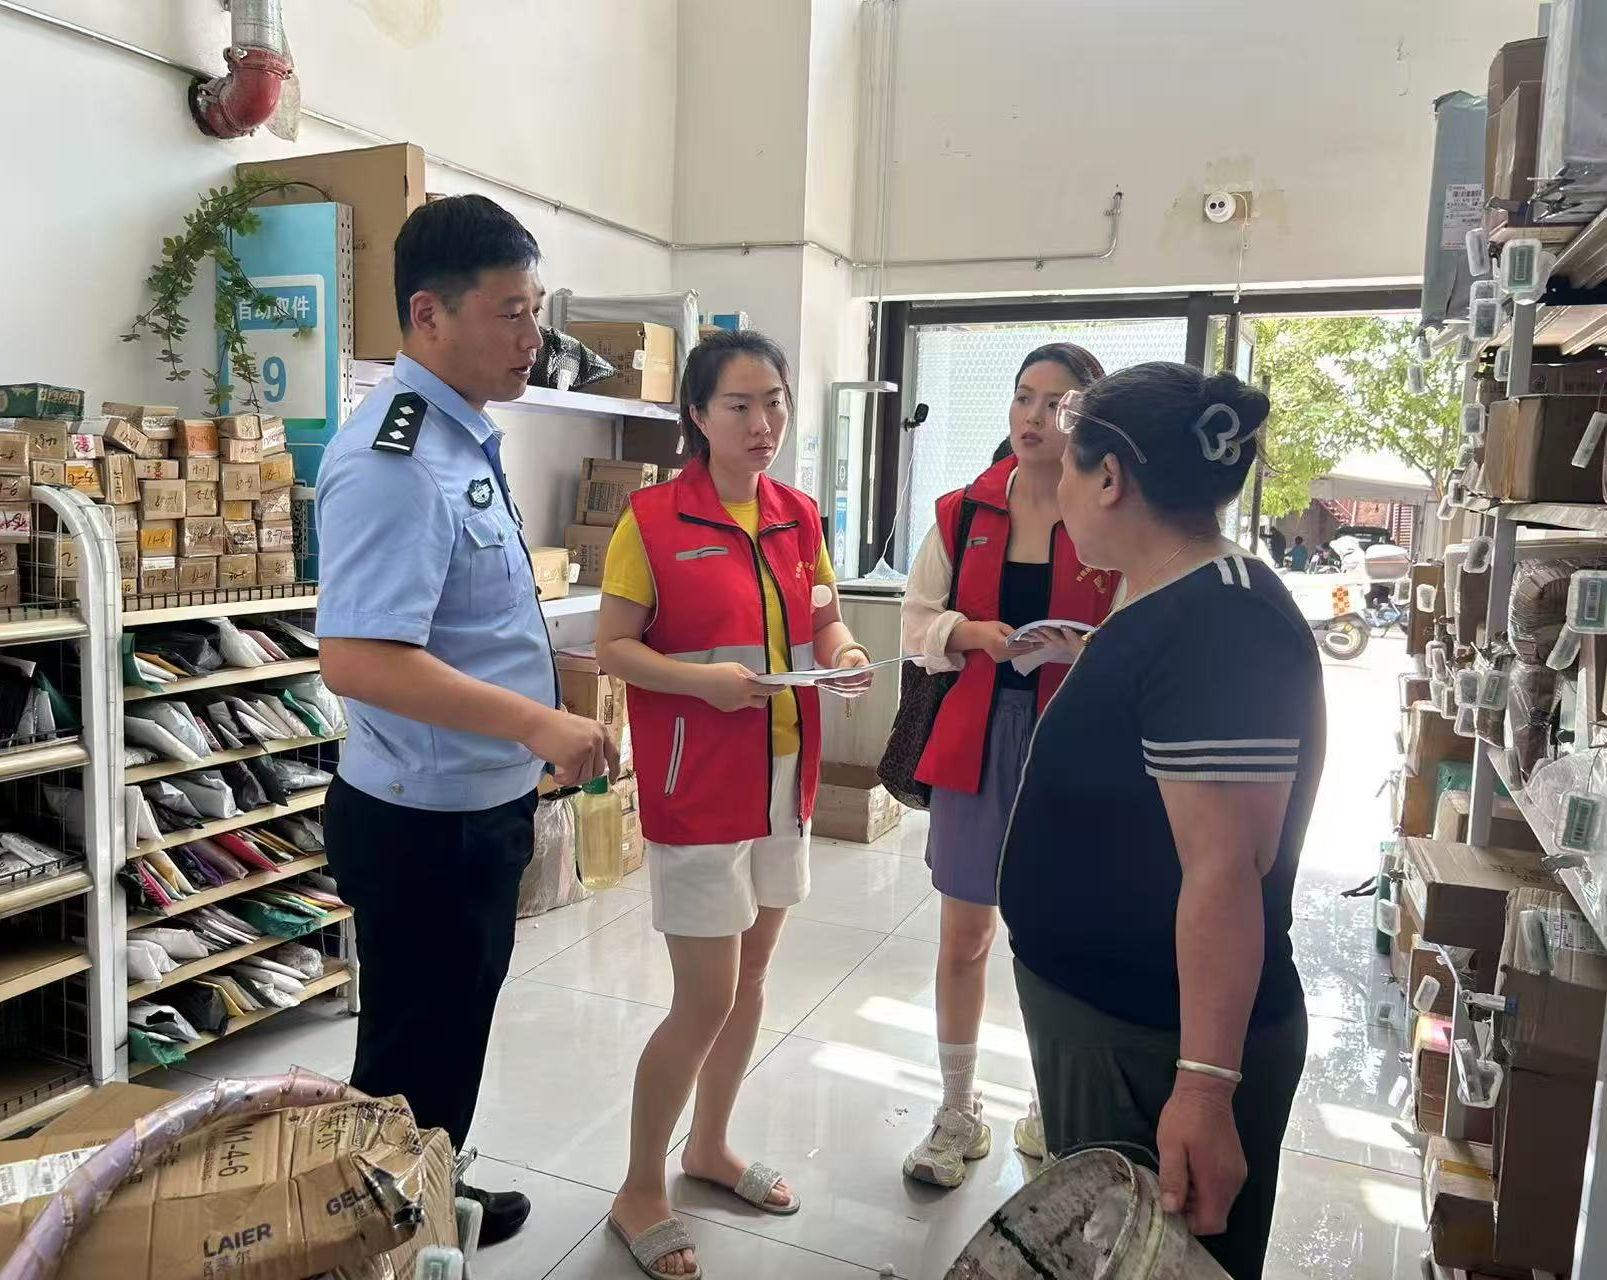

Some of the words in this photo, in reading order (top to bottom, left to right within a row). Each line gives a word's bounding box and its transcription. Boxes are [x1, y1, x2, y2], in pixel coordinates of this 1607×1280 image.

[263, 356, 286, 403] 9
[219, 1123, 254, 1177] M1-4-6
[204, 1223, 272, 1258] LAIER
